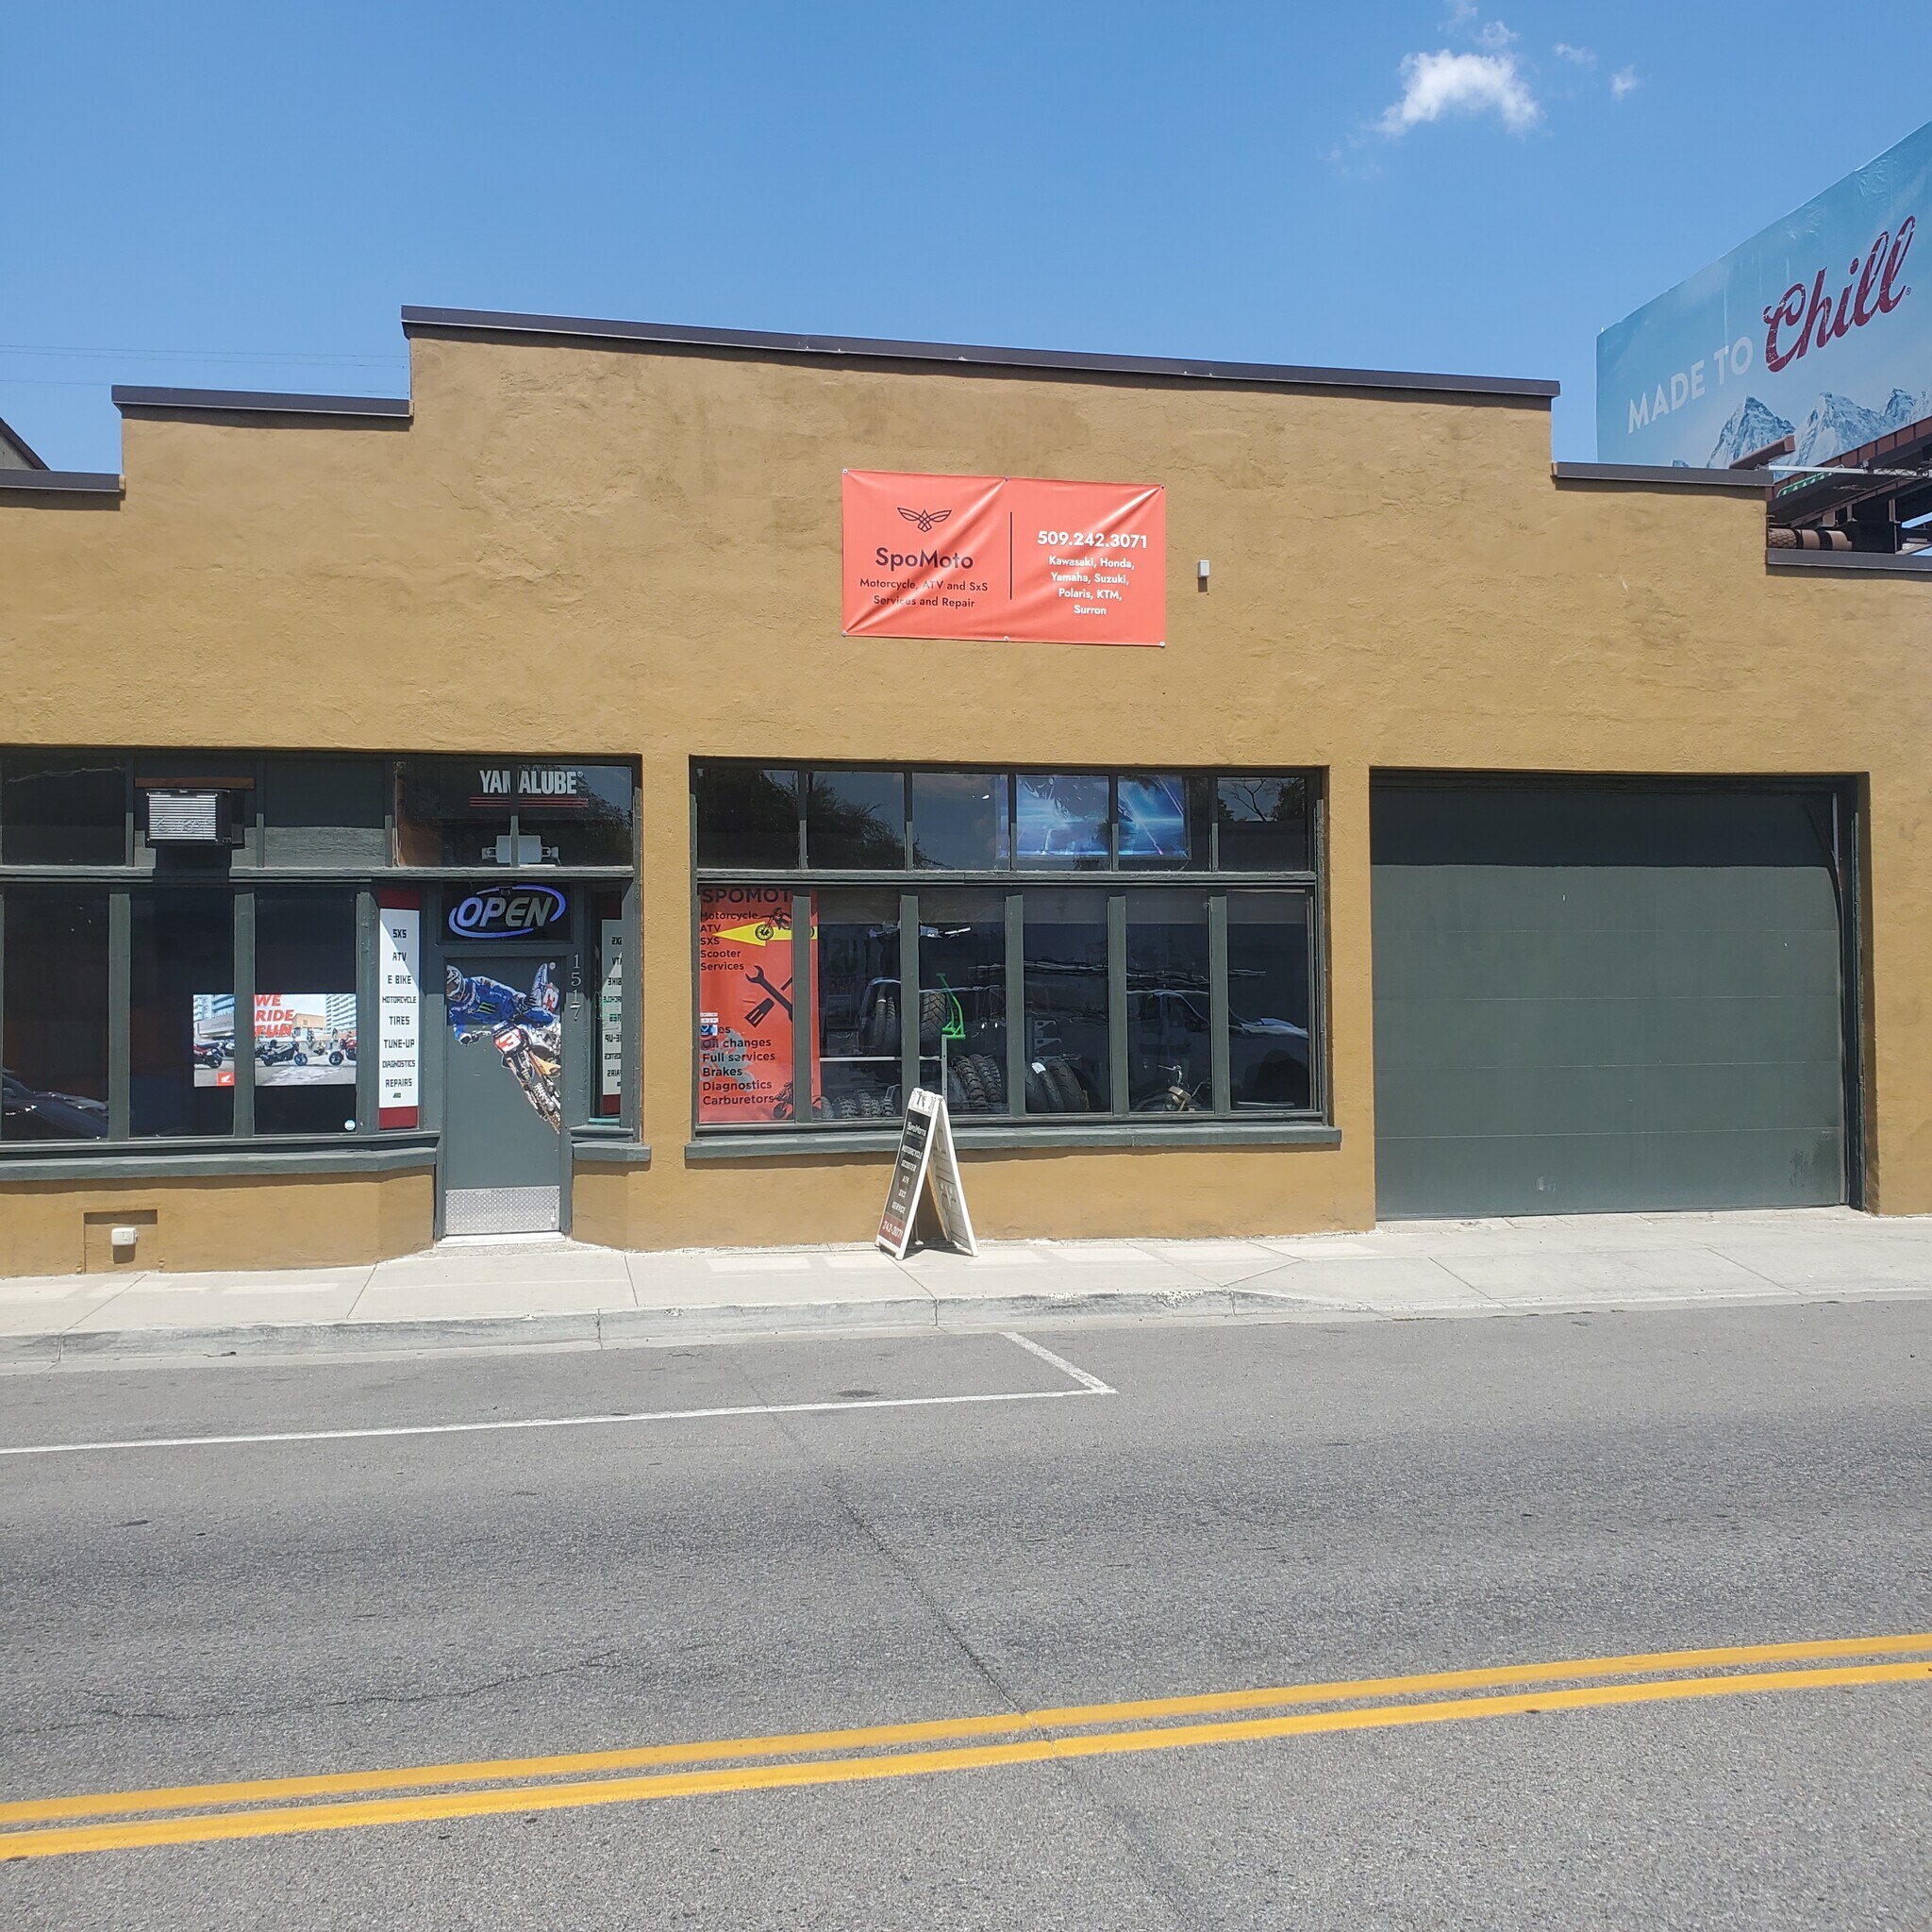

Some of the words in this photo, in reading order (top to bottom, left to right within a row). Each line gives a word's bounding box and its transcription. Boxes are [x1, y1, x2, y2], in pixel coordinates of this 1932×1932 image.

[1627, 360, 1706, 434] MADE
[1713, 336, 1754, 386] TO
[1761, 215, 1917, 373] Chill
[1037, 530, 1147, 548] 509.242.3071
[874, 547, 974, 572] SpoMoto
[1049, 556, 1097, 569] Kawasaki,
[1100, 558, 1135, 570] Honda,
[859, 578, 919, 591] Motorcycle,
[923, 580, 943, 590] ATV
[947, 581, 966, 591] and
[969, 582, 989, 591] SxS
[1051, 572, 1091, 584] Yamaha,
[1094, 574, 1129, 586] Suzuki,
[1058, 588, 1094, 600] Polaris,
[1097, 590, 1123, 601] KTM,
[874, 595, 916, 606] Services
[919, 596, 939, 607] and
[942, 598, 975, 609] Repair
[1074, 605, 1107, 615] Surron
[702, 889, 791, 904] SPOMOT
[457, 897, 553, 927] OPEN
[700, 911, 758, 921] Motorcycle
[392, 929, 407, 939] SXS
[700, 924, 721, 933] ATV
[392, 952, 407, 961] ATV
[700, 950, 741, 958] Scooter
[700, 961, 744, 971] Services
[388, 975, 392, 984] E
[395, 975, 412, 984] BIKE
[255, 993, 282, 1007] WE
[255, 1009, 294, 1022] RIDE
[389, 1016, 409, 1025] TIRES
[255, 1024, 292, 1038] FUN
[383, 1039, 415, 1048] TUNE-UP
[723, 1038, 772, 1049] changes
[702, 1053, 724, 1062] Full
[727, 1052, 775, 1062] services
[703, 1067, 743, 1077] Brakes
[385, 1078, 412, 1088] REPAIRS
[703, 1080, 773, 1091] Diagnostics
[703, 1095, 774, 1106] Carburetors
